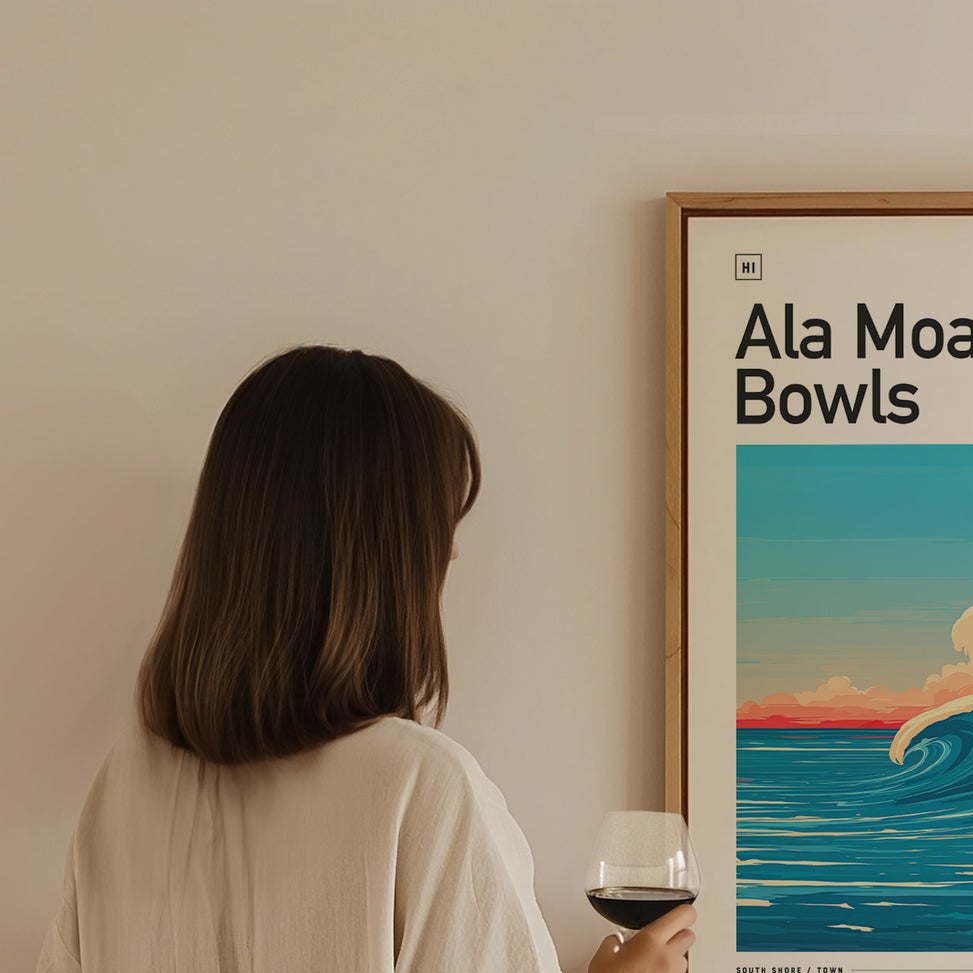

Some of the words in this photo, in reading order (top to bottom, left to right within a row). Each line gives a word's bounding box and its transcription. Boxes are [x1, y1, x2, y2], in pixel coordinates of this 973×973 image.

[742, 262, 755, 274] HI
[735, 303, 832, 359] Ala
[736, 368, 920, 425] Bowls
[736, 966, 766, 973] SOUTH
[771, 966, 801, 973] SHORE
[806, 966, 811, 973] /
[817, 966, 843, 973] TOWN
